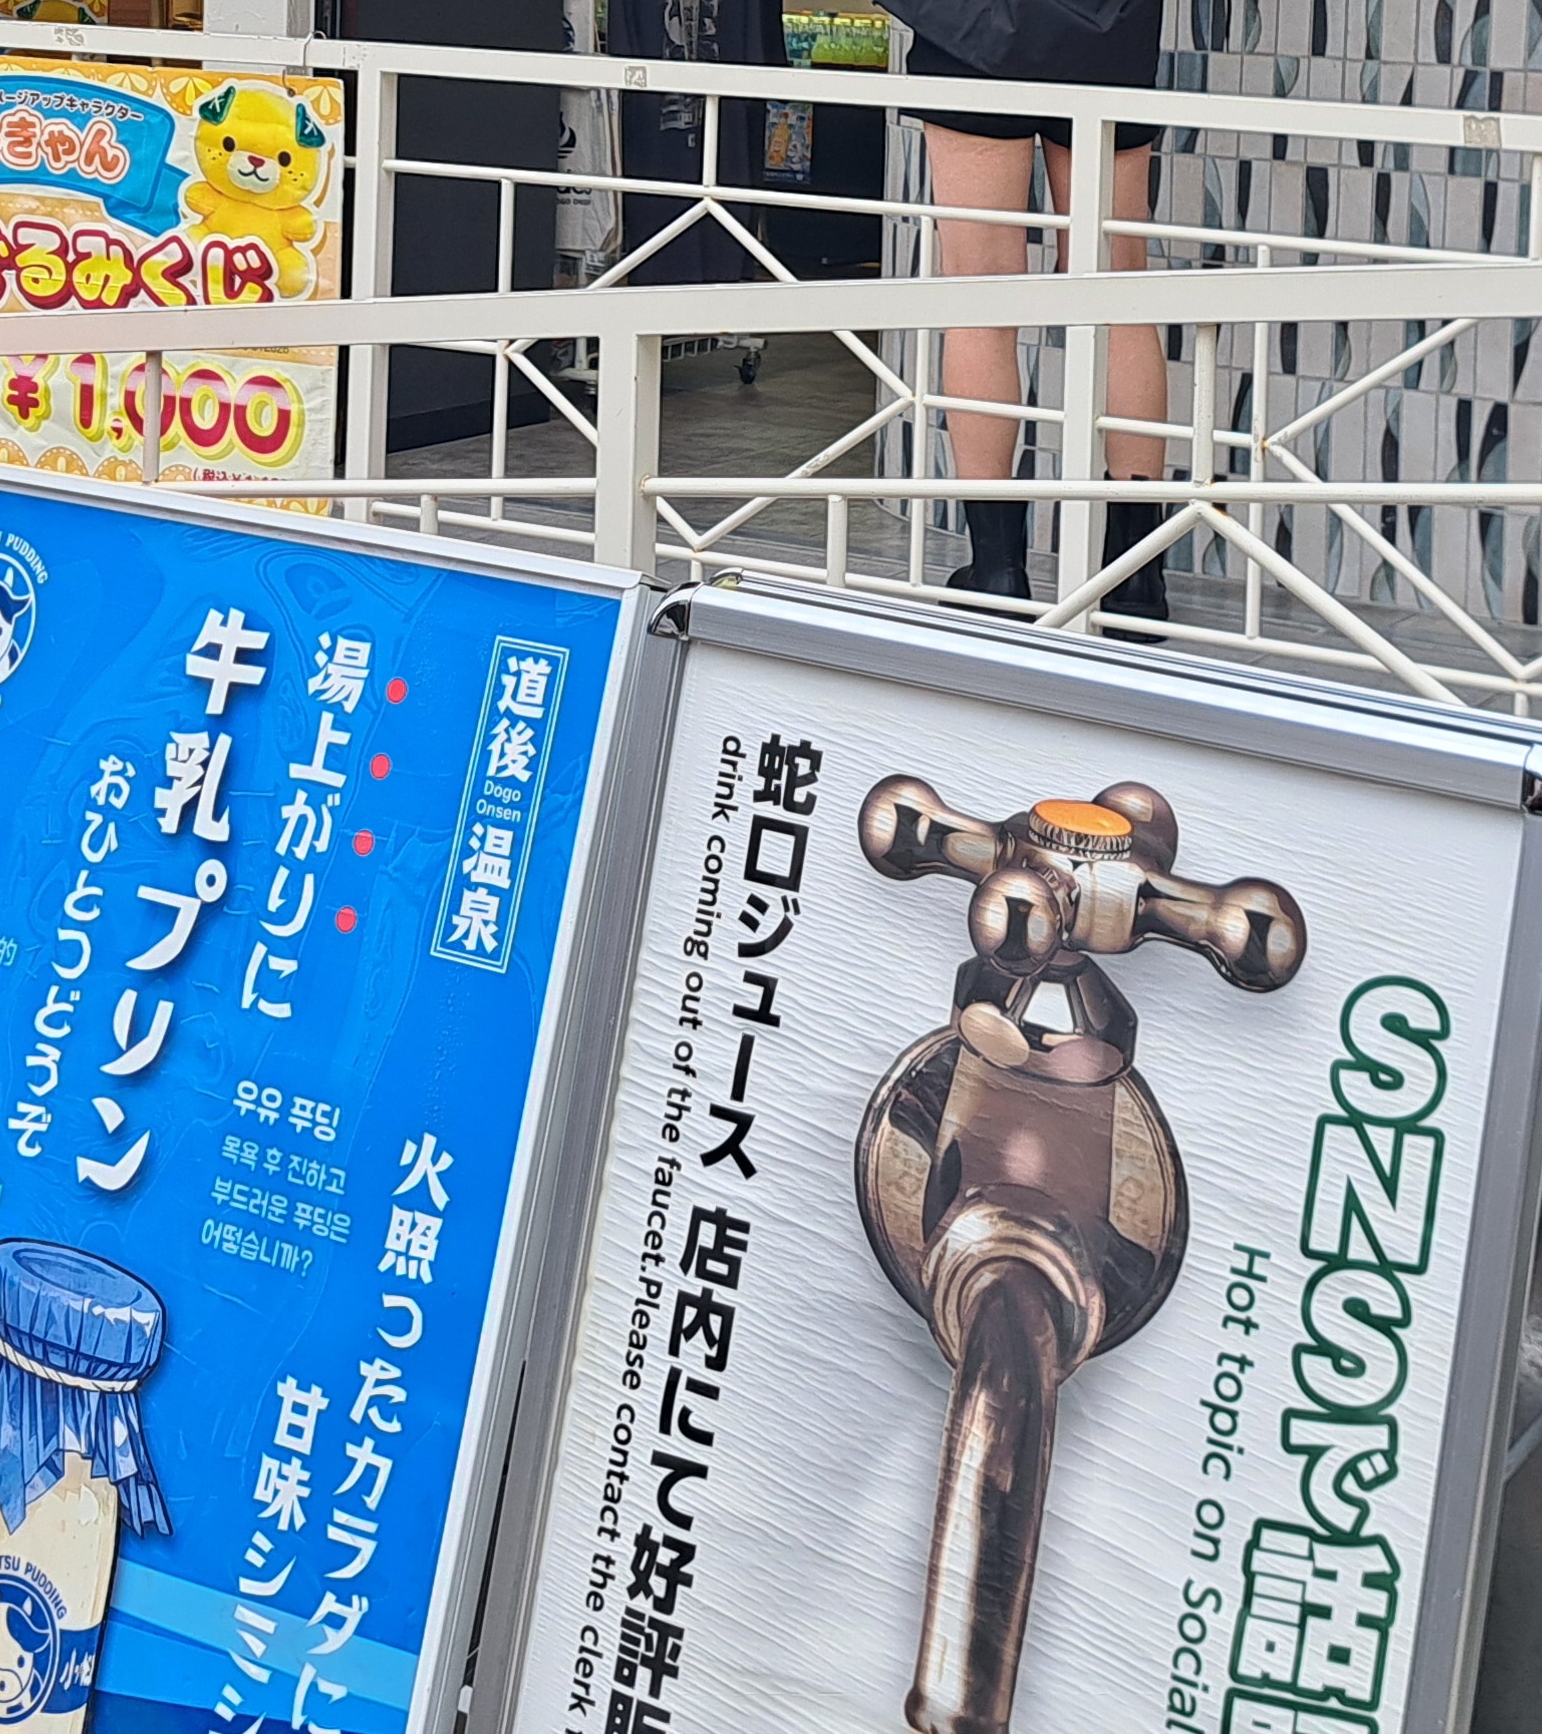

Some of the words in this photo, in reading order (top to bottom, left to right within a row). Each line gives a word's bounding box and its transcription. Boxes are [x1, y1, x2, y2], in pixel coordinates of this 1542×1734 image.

[5, 530, 50, 585] PUDDING
[484, 654, 555, 785] 道後
[241, 631, 373, 1020] 湯上がりに
[475, 797, 523, 823] Onsen
[482, 779, 523, 804] Dogo
[711, 734, 747, 823] drink
[77, 606, 272, 1193] 牛乳プリン
[446, 822, 513, 958] 温泉
[683, 834, 727, 961] coming
[7, 753, 139, 1160] おひとつどうぞ
[678, 970, 704, 1031] out
[699, 732, 824, 1180] 蛇口ジュース
[671, 1040, 697, 1080] of
[232, 1079, 283, 1127] 우유
[287, 1095, 341, 1142] 푸딩
[660, 1086, 693, 1145] the
[210, 1175, 289, 1225] 부드러운
[292, 1201, 352, 1244] 푸딩은
[221, 1134, 260, 1172] 목욕
[262, 1146, 284, 1176] 후
[287, 1153, 347, 1196] 진하고
[1221, 1240, 1272, 1337] Hot
[1221, 974, 1452, 1734] SNSで話
[291, 1132, 455, 1734] 火照ったカラダに
[1198, 1352, 1257, 1484] topic
[596, 1401, 637, 1544] contact
[1189, 1497, 1227, 1563] on
[24, 1561, 68, 1621] PUDDING
[585, 1551, 617, 1614] the
[567, 1624, 605, 1719] clerk
[1165, 1578, 1223, 1734] Social
